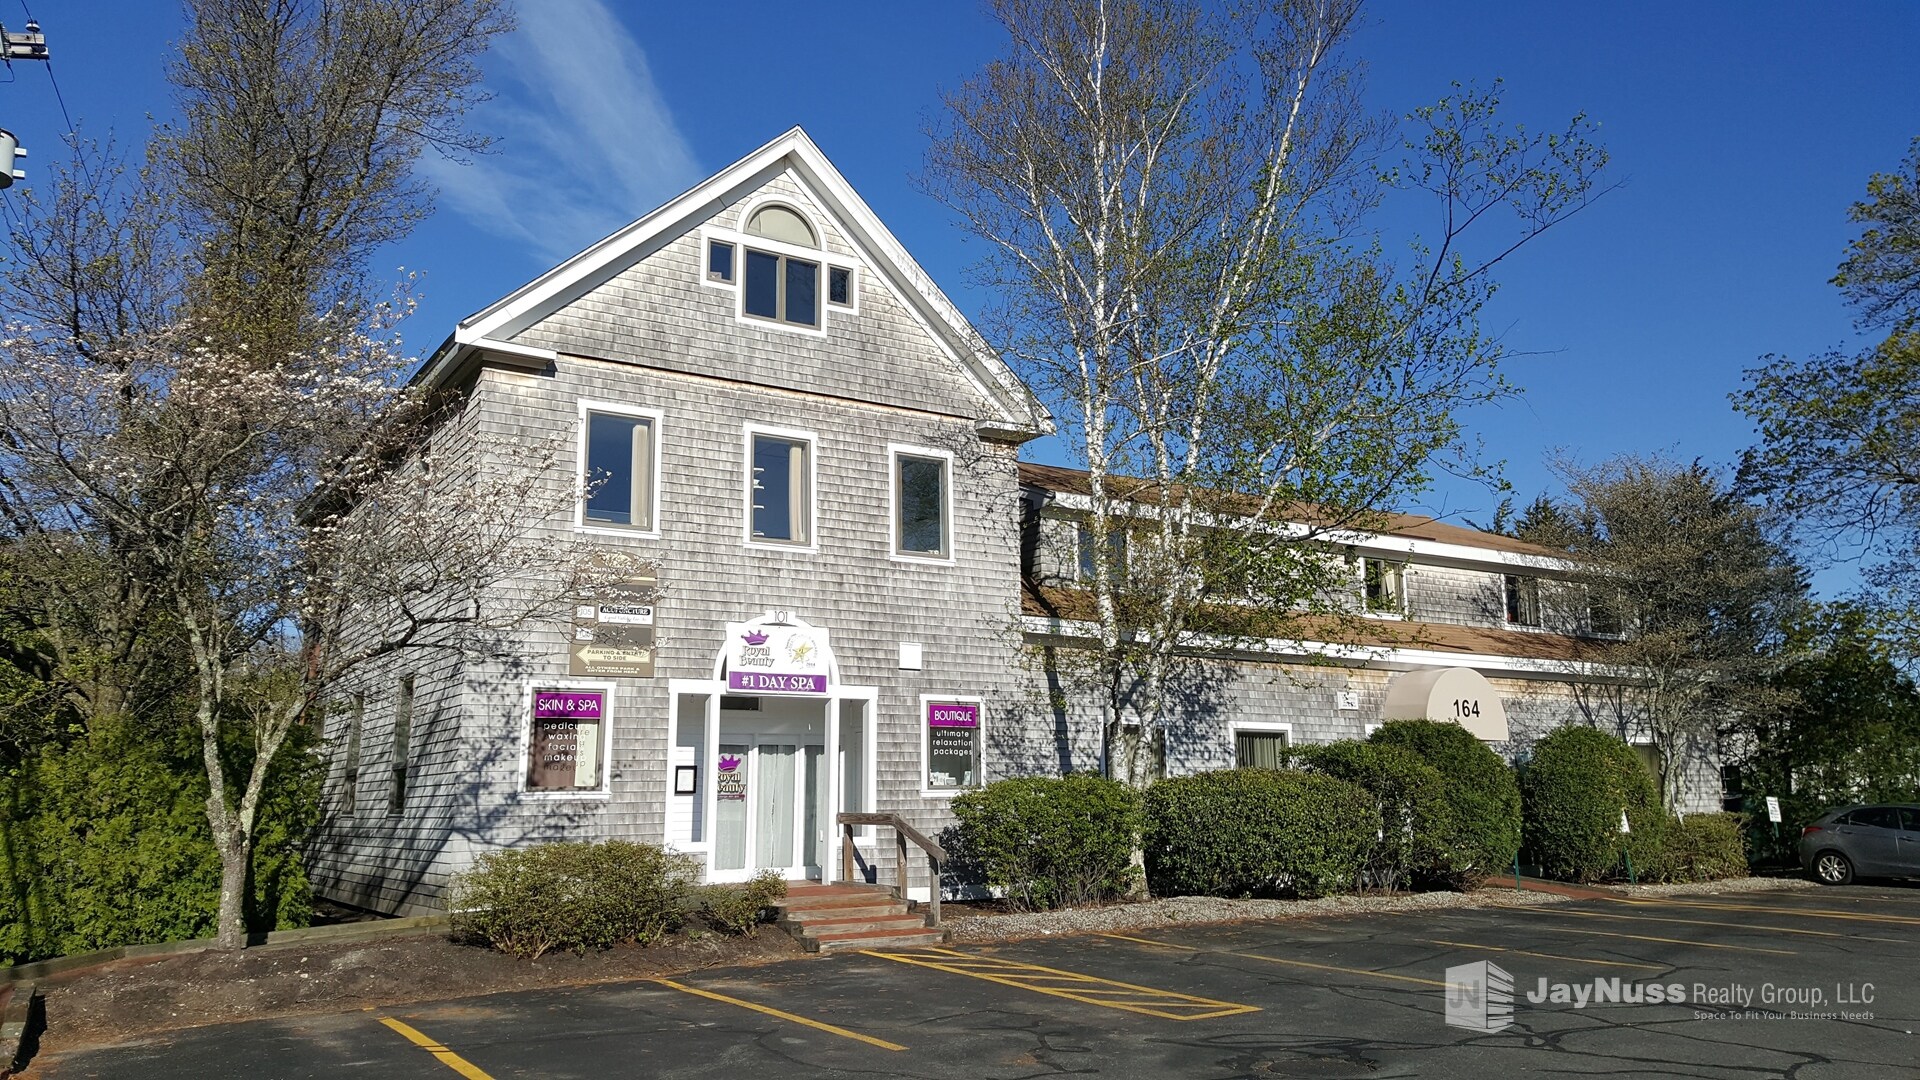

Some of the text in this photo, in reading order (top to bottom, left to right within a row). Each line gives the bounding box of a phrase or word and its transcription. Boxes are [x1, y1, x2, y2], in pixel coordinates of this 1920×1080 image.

[774, 610, 788, 623] 101
[743, 645, 771, 657] Royal
[739, 656, 775, 668] Beauty
[741, 675, 816, 690] #1 DAY SPA
[538, 698, 598, 711] SKIN & SPA
[1453, 699, 1480, 717] 164
[934, 710, 973, 722] BOUTIQUE
[544, 722, 585, 731] pedicu
[548, 743, 584, 751] facial
[933, 748, 973, 756] packages
[718, 772, 741, 784] oyal
[718, 783, 746, 794] eauty
